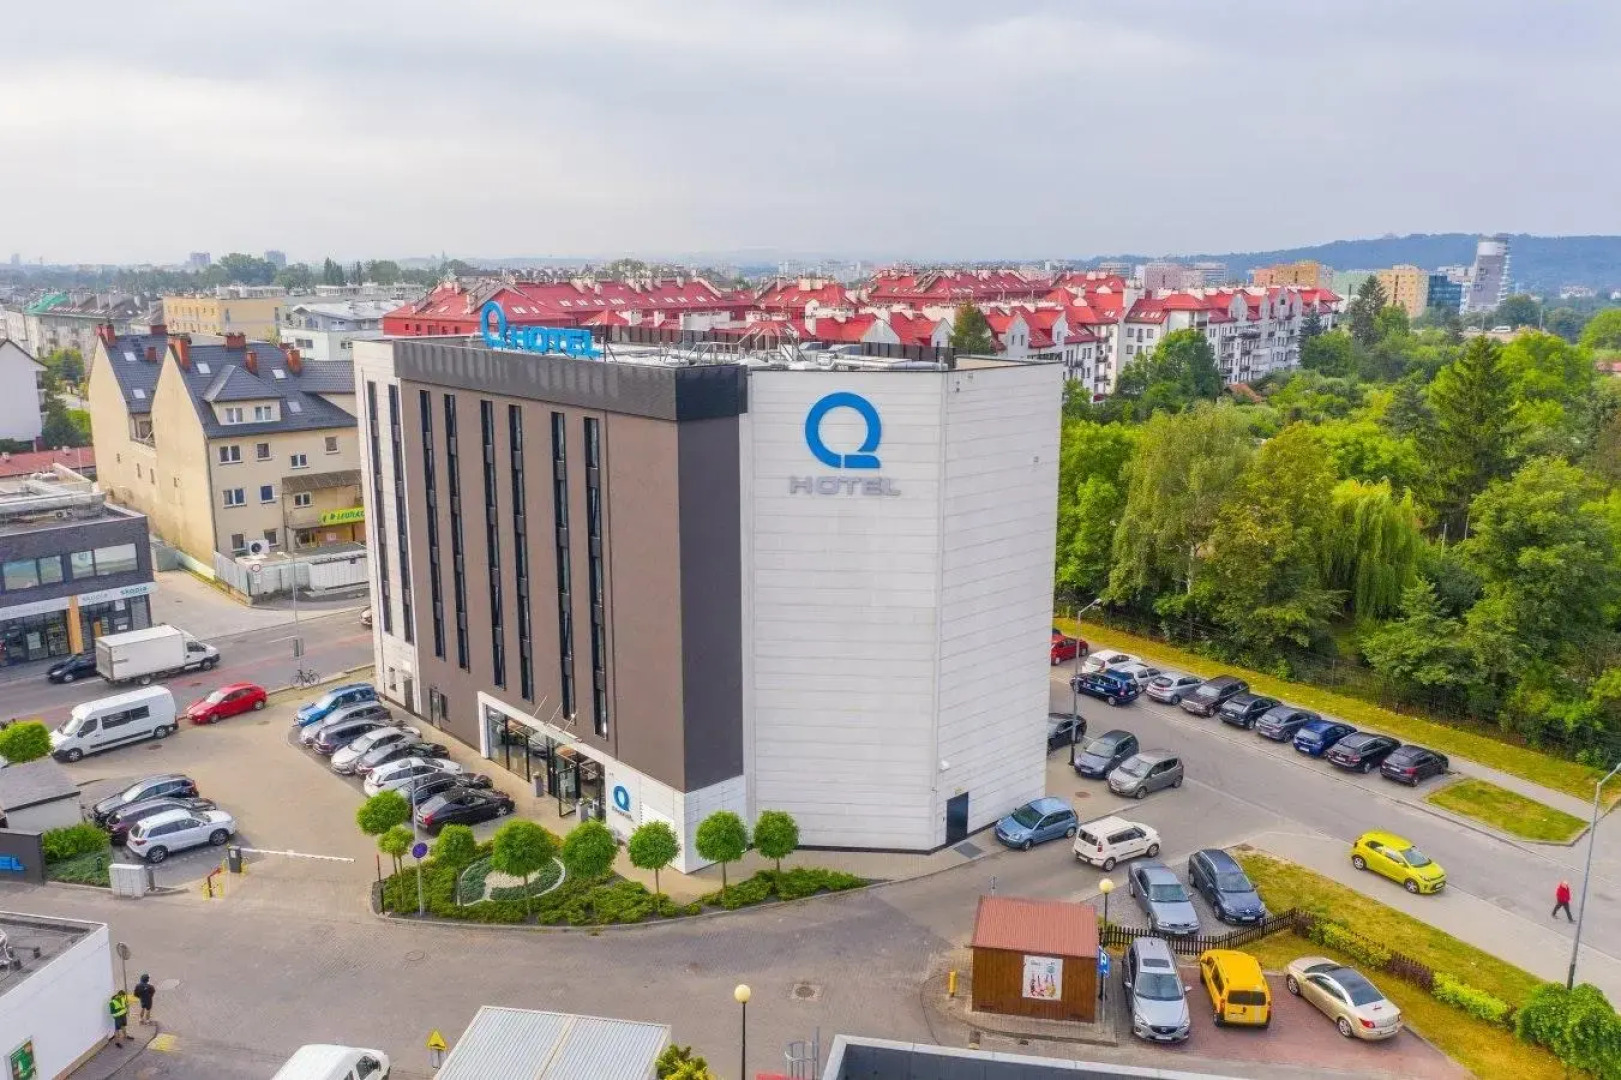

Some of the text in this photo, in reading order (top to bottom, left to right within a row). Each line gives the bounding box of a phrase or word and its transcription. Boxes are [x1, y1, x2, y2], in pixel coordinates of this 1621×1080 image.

[480, 300, 603, 356] Q HOTEL
[804, 391, 882, 469] Q
[788, 476, 902, 497] HOTEL
